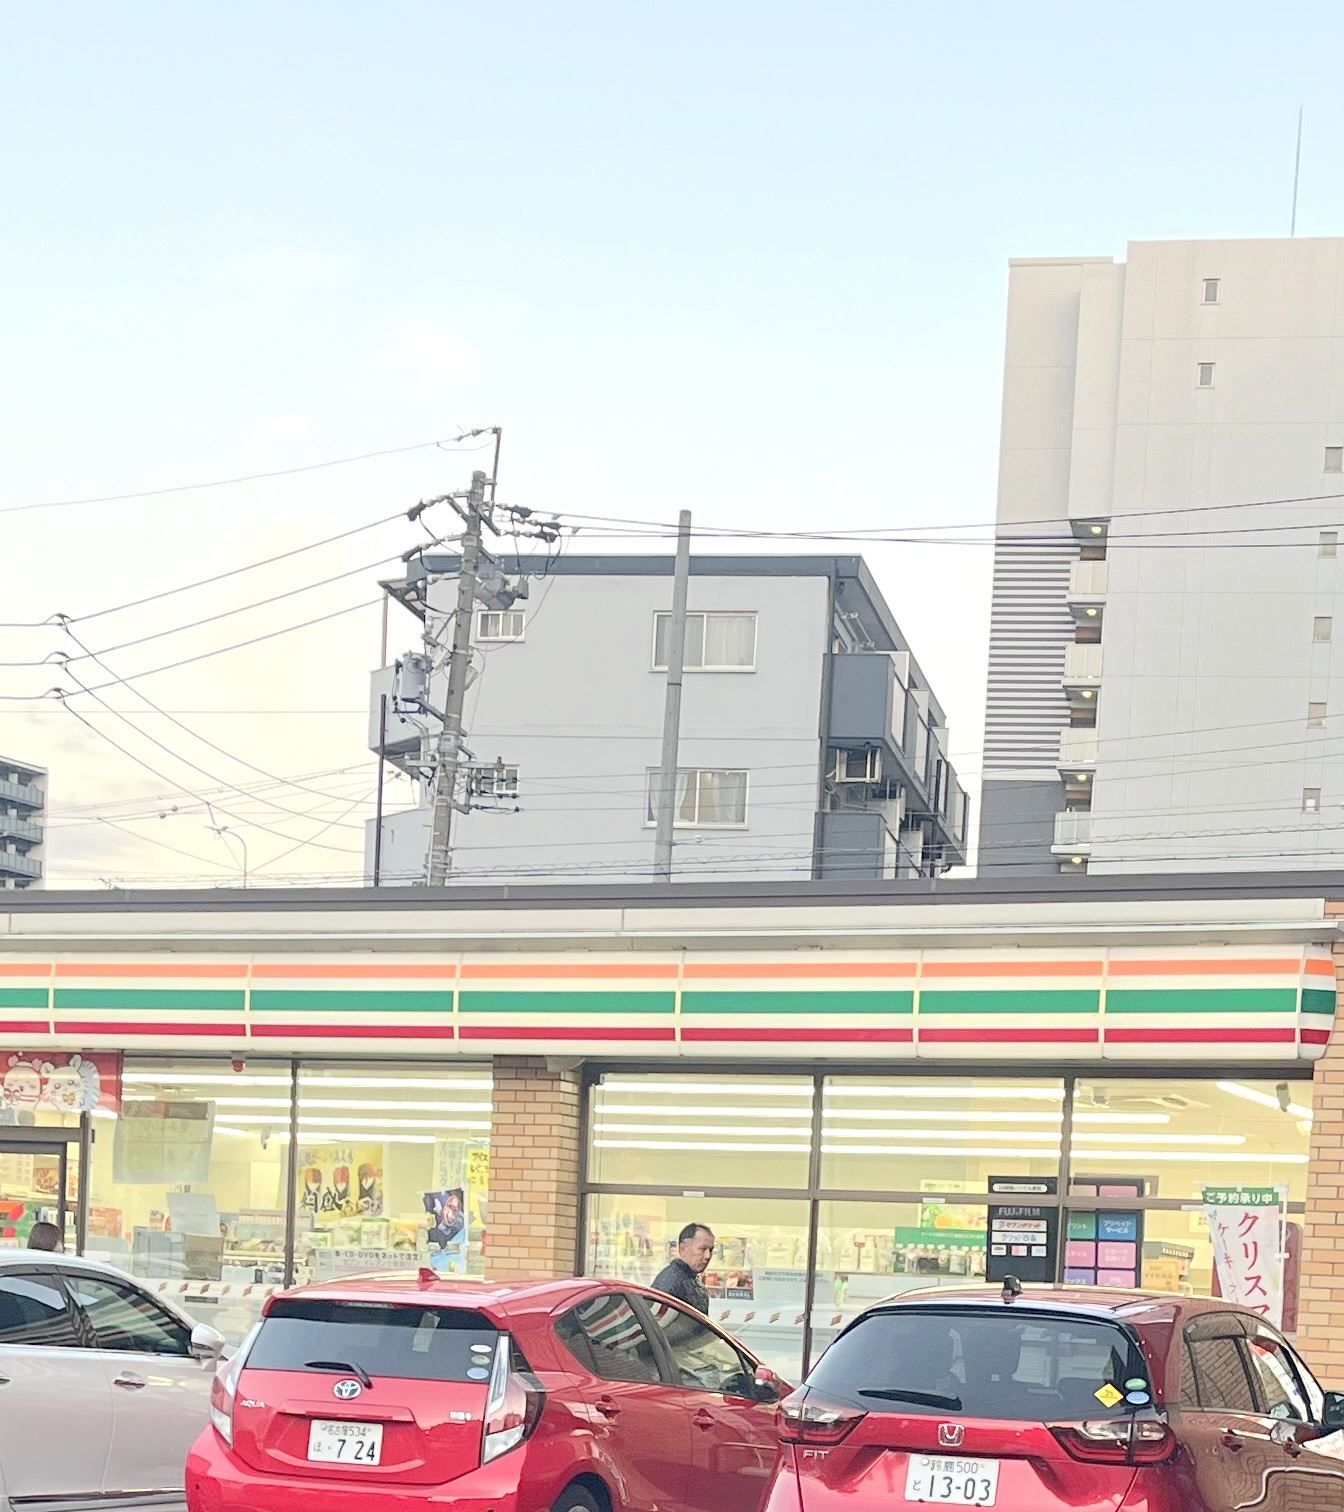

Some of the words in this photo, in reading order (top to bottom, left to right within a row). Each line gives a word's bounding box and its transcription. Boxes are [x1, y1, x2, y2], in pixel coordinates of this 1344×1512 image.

[1206, 1192, 1273, 1205] ご予約承り中
[803, 1450, 830, 1460] FIT
[912, 1480, 921, 1491] と
[929, 1475, 992, 1501] 13-03
